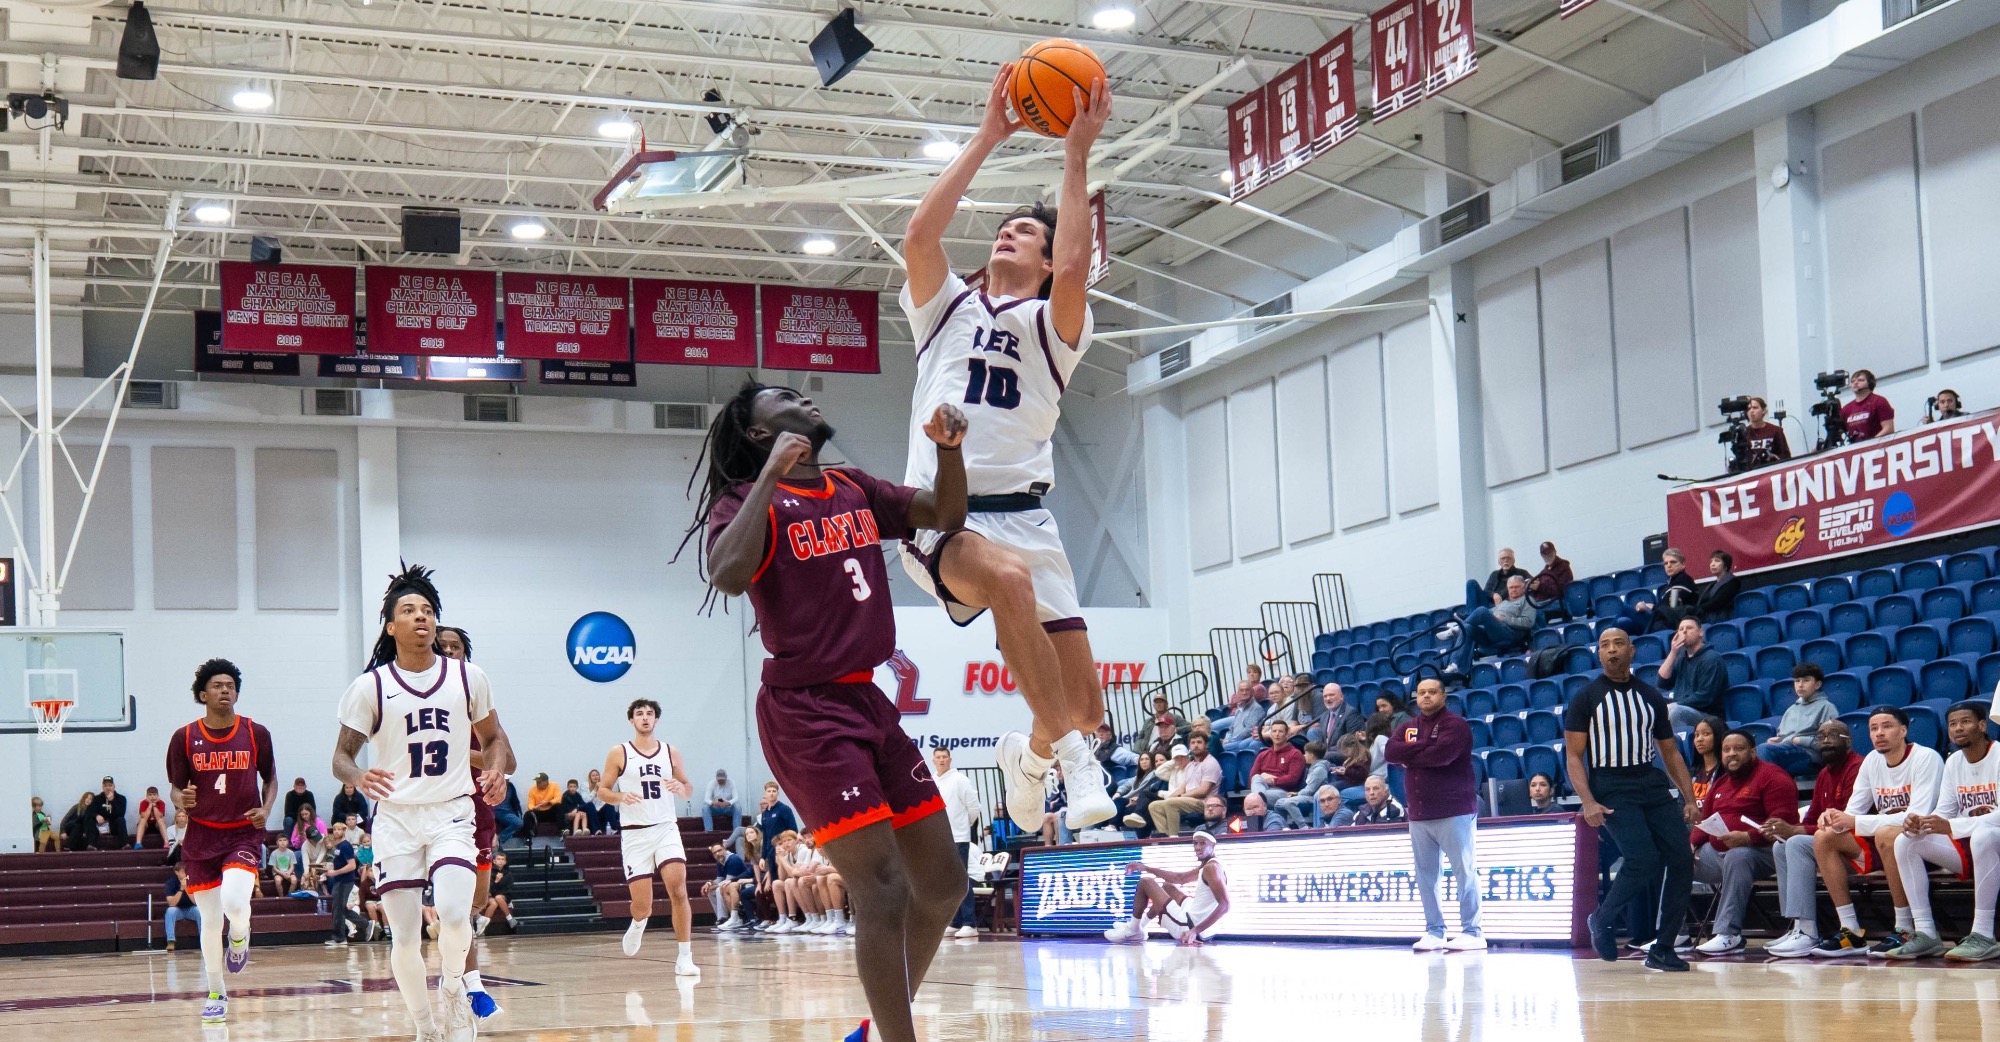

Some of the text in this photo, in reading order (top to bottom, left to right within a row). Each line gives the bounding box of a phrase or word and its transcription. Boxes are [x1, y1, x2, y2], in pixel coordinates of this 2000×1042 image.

[1437, 0, 1461, 43] 22
[1385, 20, 1407, 70] 44
[1328, 61, 1339, 104] 5
[1280, 89, 1297, 134] 13
[1243, 115, 1252, 155] 3
[256, 271, 321, 286] NCCAA
[400, 275, 463, 291] NCCAA
[246, 284, 331, 300] NATIONAL
[391, 288, 472, 303] NATIONAL
[536, 281, 597, 296] NCCAA
[665, 287, 724, 301] NCCAA
[241, 297, 336, 313] CHAMPIONS
[386, 301, 477, 317] CHAMPIONS
[508, 293, 624, 309] NATIONAL INVITATIONAL
[657, 299, 733, 314] NATIONAL
[792, 294, 849, 309] NCCAA
[227, 310, 259, 324] MEN'S
[264, 312, 297, 326] CROSS
[302, 315, 349, 328] COUNTRY
[523, 306, 611, 321] CHAMPIONS
[653, 312, 738, 327] CHAMPIONS
[784, 307, 857, 322] NATIONAL
[396, 315, 467, 330] MEN'S GOLF
[525, 320, 609, 335] WOMEN'S GOLF
[780, 319, 862, 334] CHAMPIONS
[277, 334, 302, 346] 2013
[657, 326, 735, 340] MEN'S SOCCER
[776, 331, 867, 347] WOMEN'S SOCCER
[420, 337, 444, 348] 2013
[556, 342, 580, 353] 2013
[685, 347, 708, 358] 2014
[811, 354, 833, 364] 2014
[964, 358, 1021, 410] 10
[1750, 437, 1774, 450] EE
[1701, 421, 2000, 527] LEE UNIVERSITY
[1819, 498, 1874, 529] ESPN
[1819, 520, 1873, 541] CLEVELAND
[844, 558, 871, 601] 3
[573, 646, 635, 665] NCAA
[964, 662, 1145, 692] FOO ITY
[404, 708, 450, 736] LEE
[193, 751, 250, 771] CLAFLIN
[407, 740, 449, 778] 13
[638, 764, 662, 778] LEE
[214, 773, 227, 794] 4
[641, 781, 662, 800] 15
[1258, 873, 1288, 903] LEE
